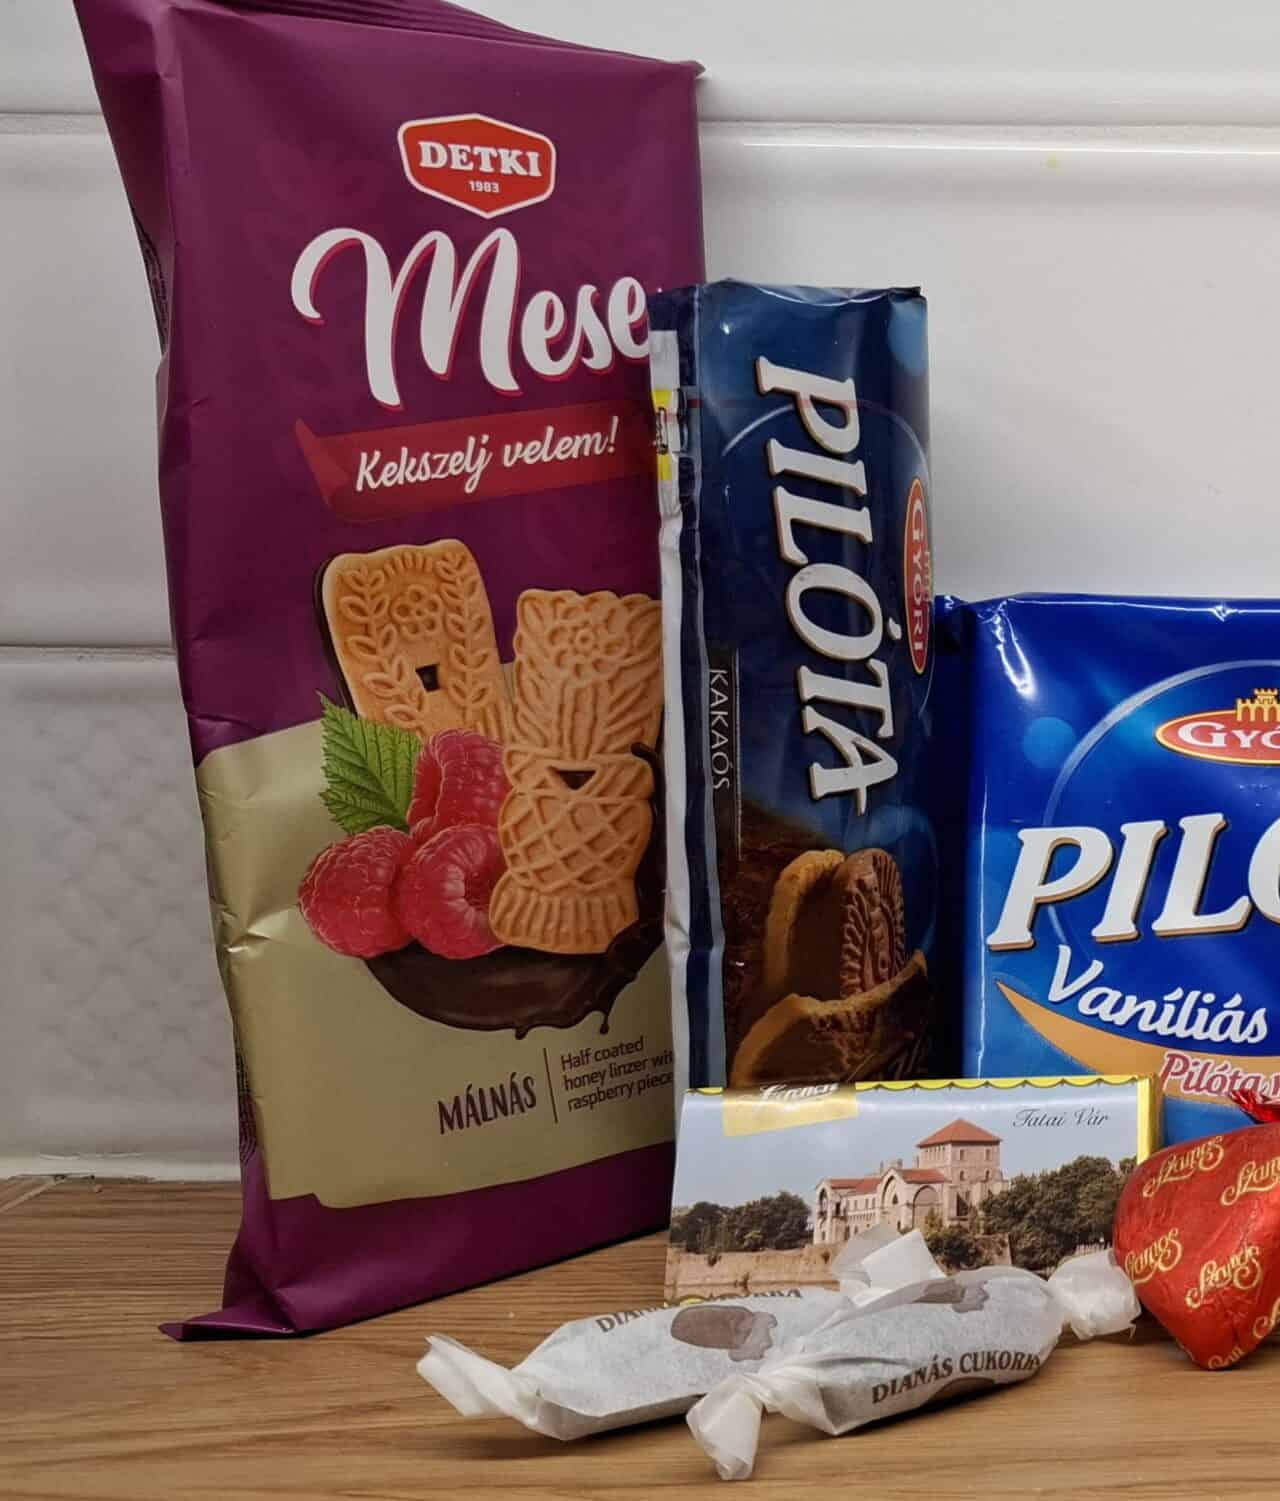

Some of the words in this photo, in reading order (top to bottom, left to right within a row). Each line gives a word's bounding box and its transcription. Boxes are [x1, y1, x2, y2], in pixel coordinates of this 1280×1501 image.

[418, 140, 541, 178] DETKI
[291, 227, 650, 409] Mese
[356, 433, 492, 492] Kekszelj
[503, 415, 620, 466] velem!
[756, 355, 901, 816] PILÓTA
[709, 668, 733, 790] KAKAÓS
[1047, 944, 1267, 1044] Vaníliás
[560, 1050, 592, 1071] Half
[594, 1036, 645, 1062] coated
[562, 1069, 607, 1092] honey
[609, 1058, 649, 1078] linzer
[1159, 1051, 1267, 1097] Pilóta
[438, 1072, 537, 1134] MÁLNÁS
[567, 1081, 633, 1112] raspberry
[871, 1354, 953, 1404] DIANÁS
